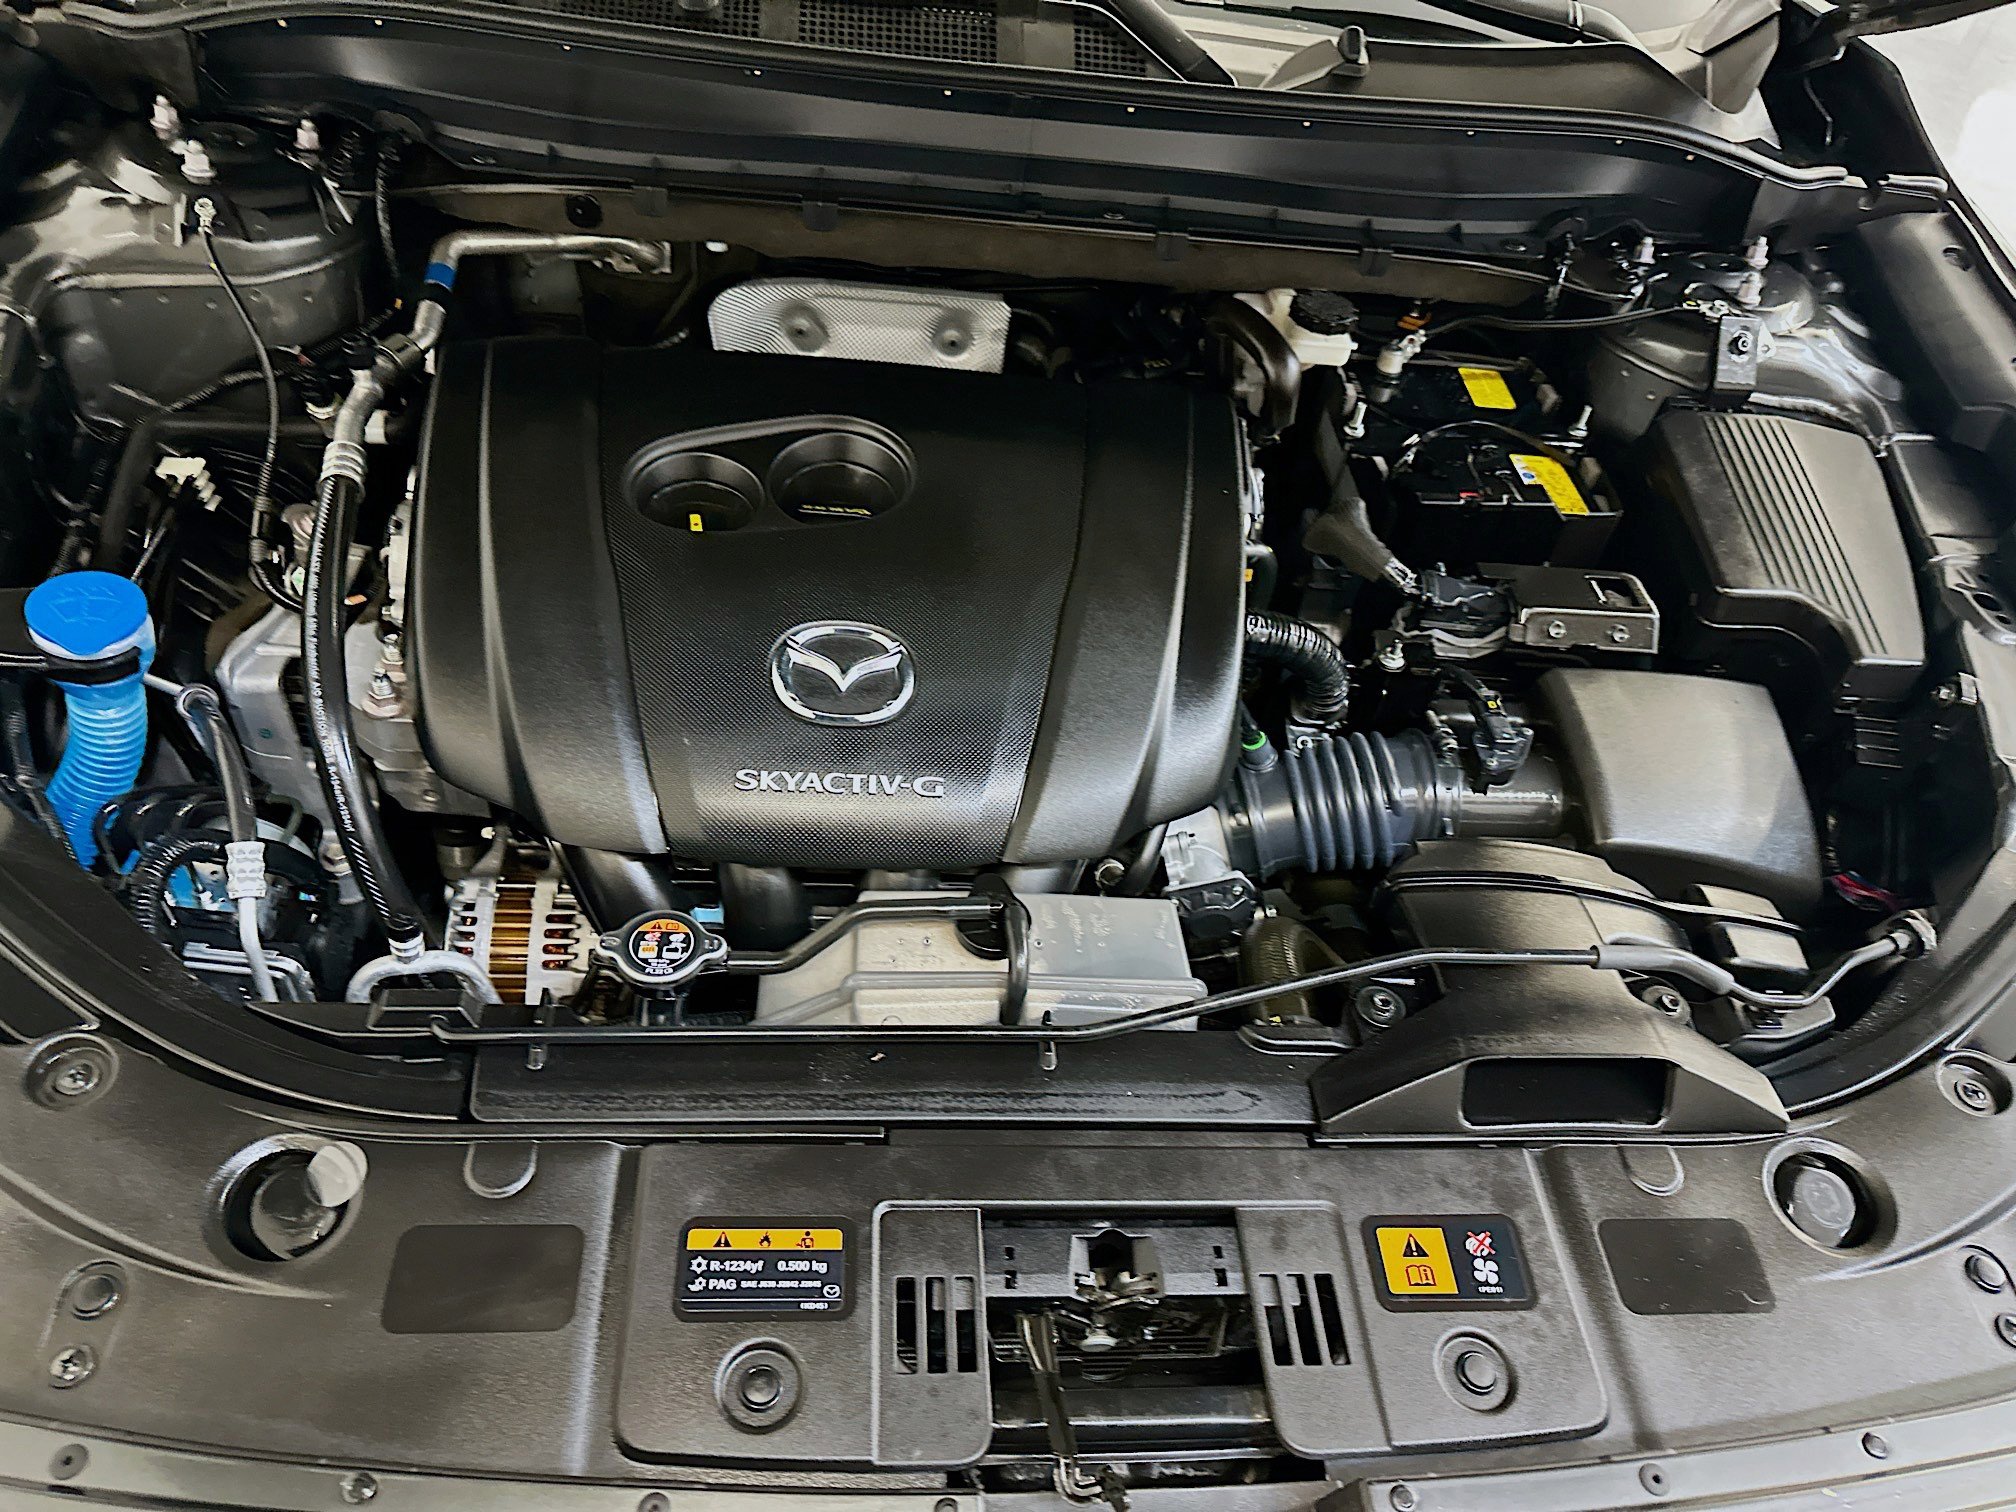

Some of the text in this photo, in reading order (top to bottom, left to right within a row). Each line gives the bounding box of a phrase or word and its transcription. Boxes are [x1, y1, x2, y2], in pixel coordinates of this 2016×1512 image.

[311, 697, 328, 737] SUCTION
[321, 738, 336, 763] HOSE
[734, 768, 945, 798] SKYACTIV-G
[709, 1260, 828, 1274] R-1234yf 0.500 kg
[708, 1279, 737, 1291] PAG
